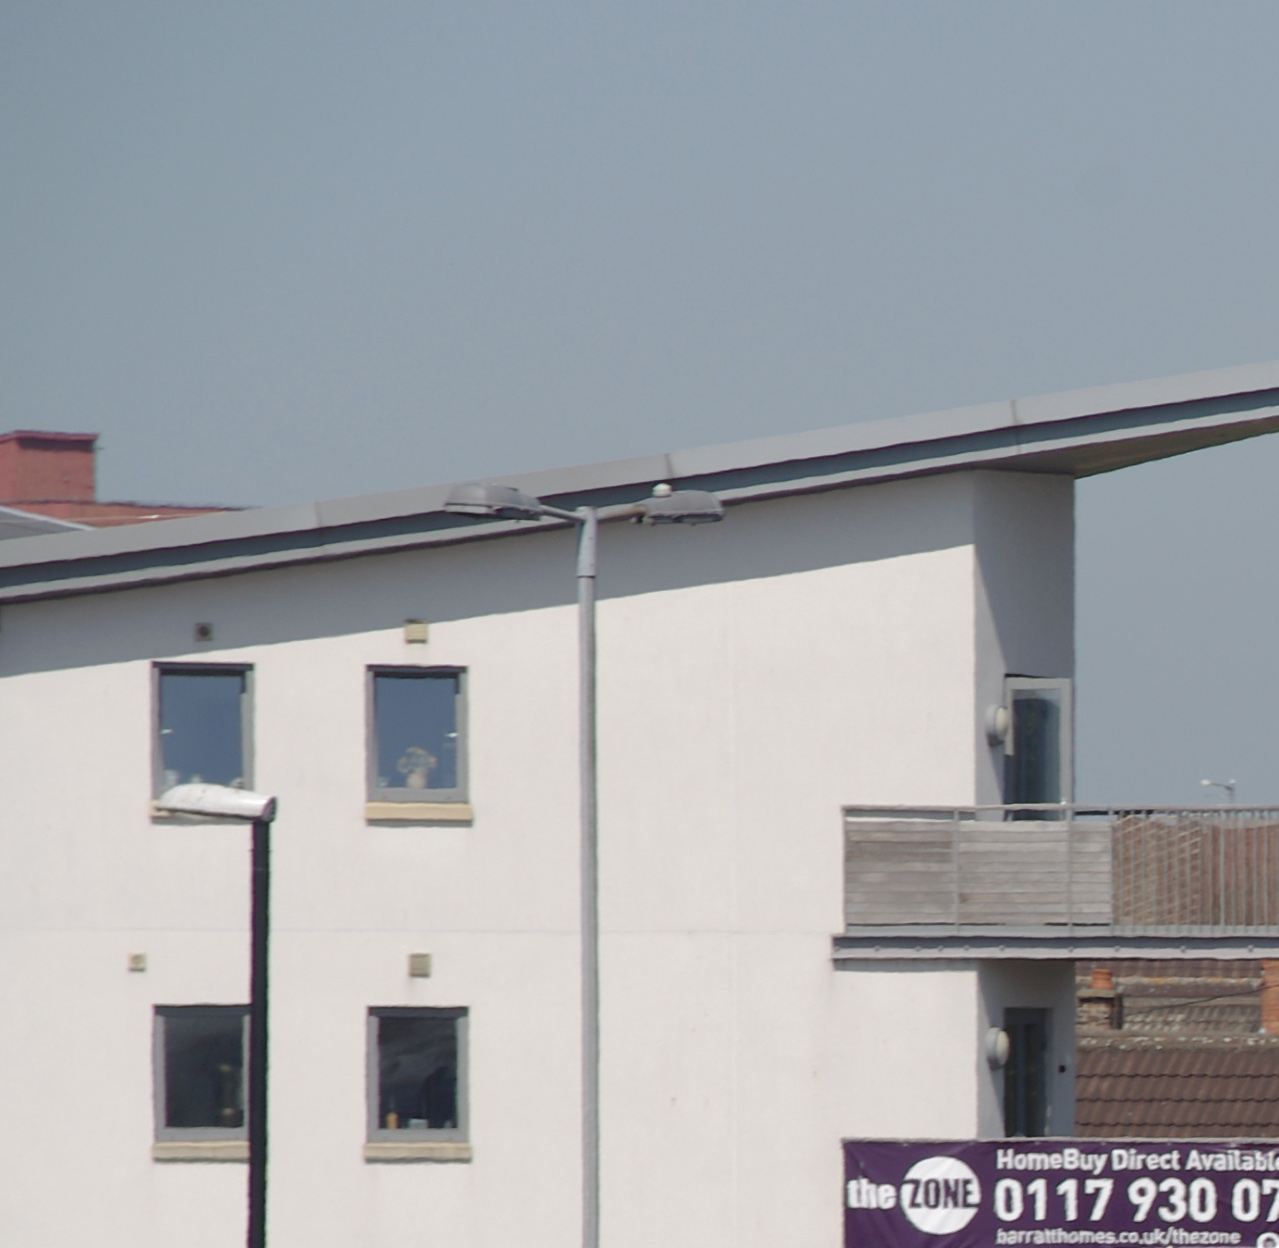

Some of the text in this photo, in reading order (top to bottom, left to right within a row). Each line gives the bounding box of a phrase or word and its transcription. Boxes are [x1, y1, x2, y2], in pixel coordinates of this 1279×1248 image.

[996, 1148, 1109, 1175] HomeBuy
[1111, 1149, 1181, 1171] Direct
[847, 1177, 974, 1210] the ZONE
[994, 1178, 1114, 1222] 0117
[1127, 1177, 1218, 1223] 930
[995, 1227, 1242, 1246] barratthomes.co.uk/thezone
